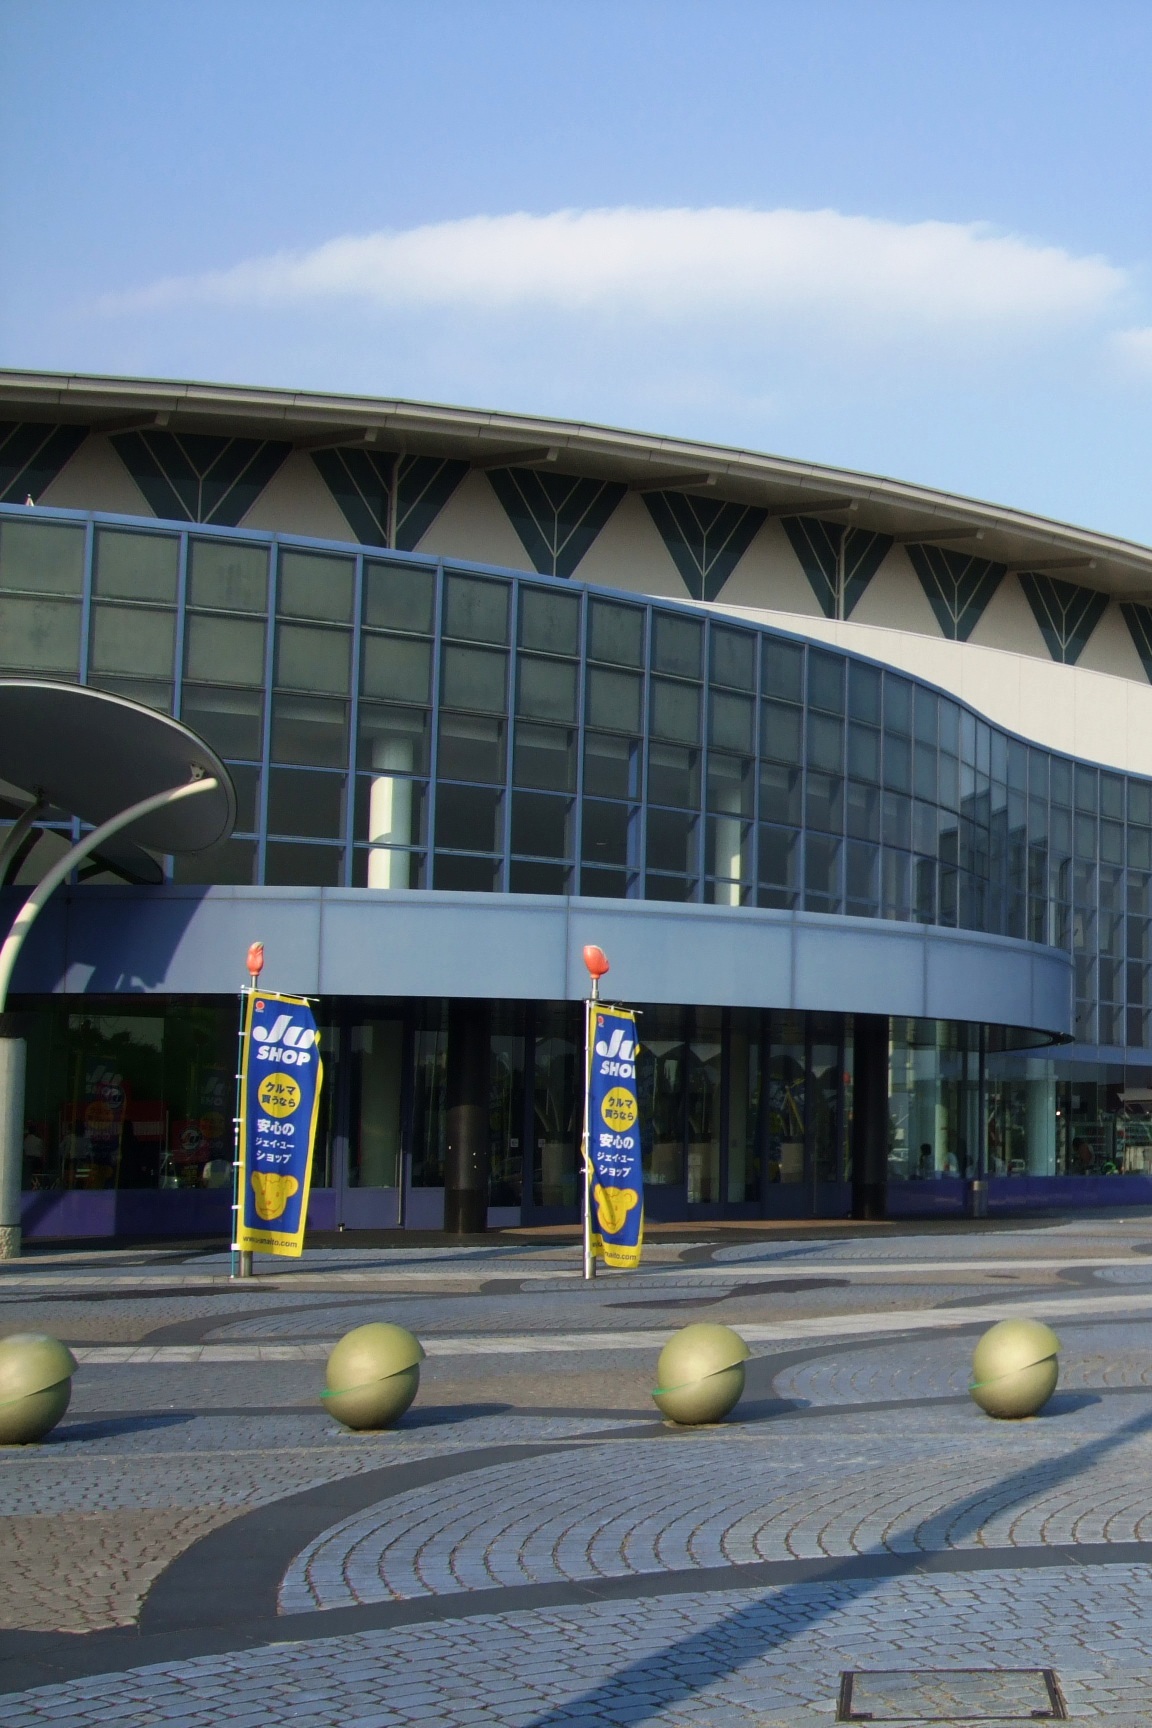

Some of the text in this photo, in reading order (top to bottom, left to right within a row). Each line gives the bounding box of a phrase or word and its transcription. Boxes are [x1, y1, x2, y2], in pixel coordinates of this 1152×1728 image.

[256, 1045, 311, 1066] SHOP
[265, 1081, 296, 1096] クルマ
[261, 1094, 296, 1108] 買うなら
[608, 1096, 633, 1109] クルマ
[604, 1108, 634, 1121] 買うなら
[257, 1118, 295, 1136] 安心の
[599, 1133, 635, 1150] 安心の
[256, 1150, 292, 1164] ショップ
[599, 1164, 632, 1178] ショップ
